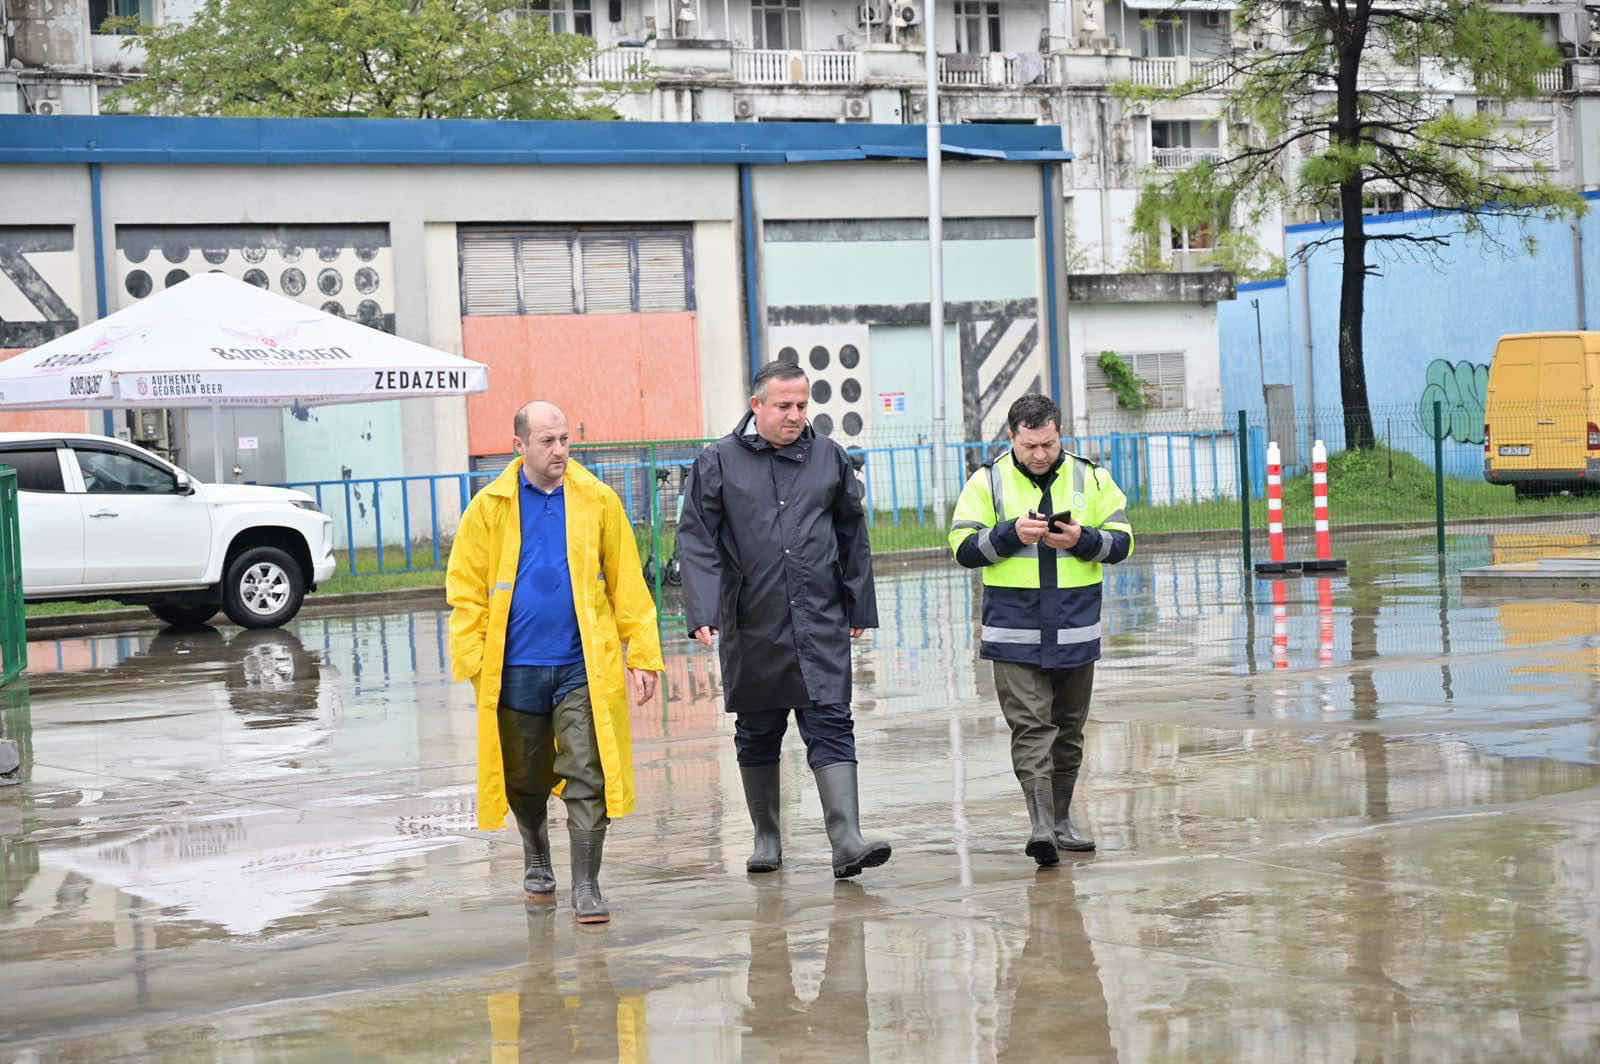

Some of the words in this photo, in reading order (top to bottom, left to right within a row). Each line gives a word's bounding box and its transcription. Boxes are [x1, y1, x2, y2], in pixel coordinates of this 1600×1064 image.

[210, 346, 352, 361] ზედაზენი
[151, 374, 201, 385] AUTHENTIC
[374, 370, 466, 389] ZEDAZENI
[152, 385, 197, 396] GEORGIAN
[200, 383, 223, 394] BEER
